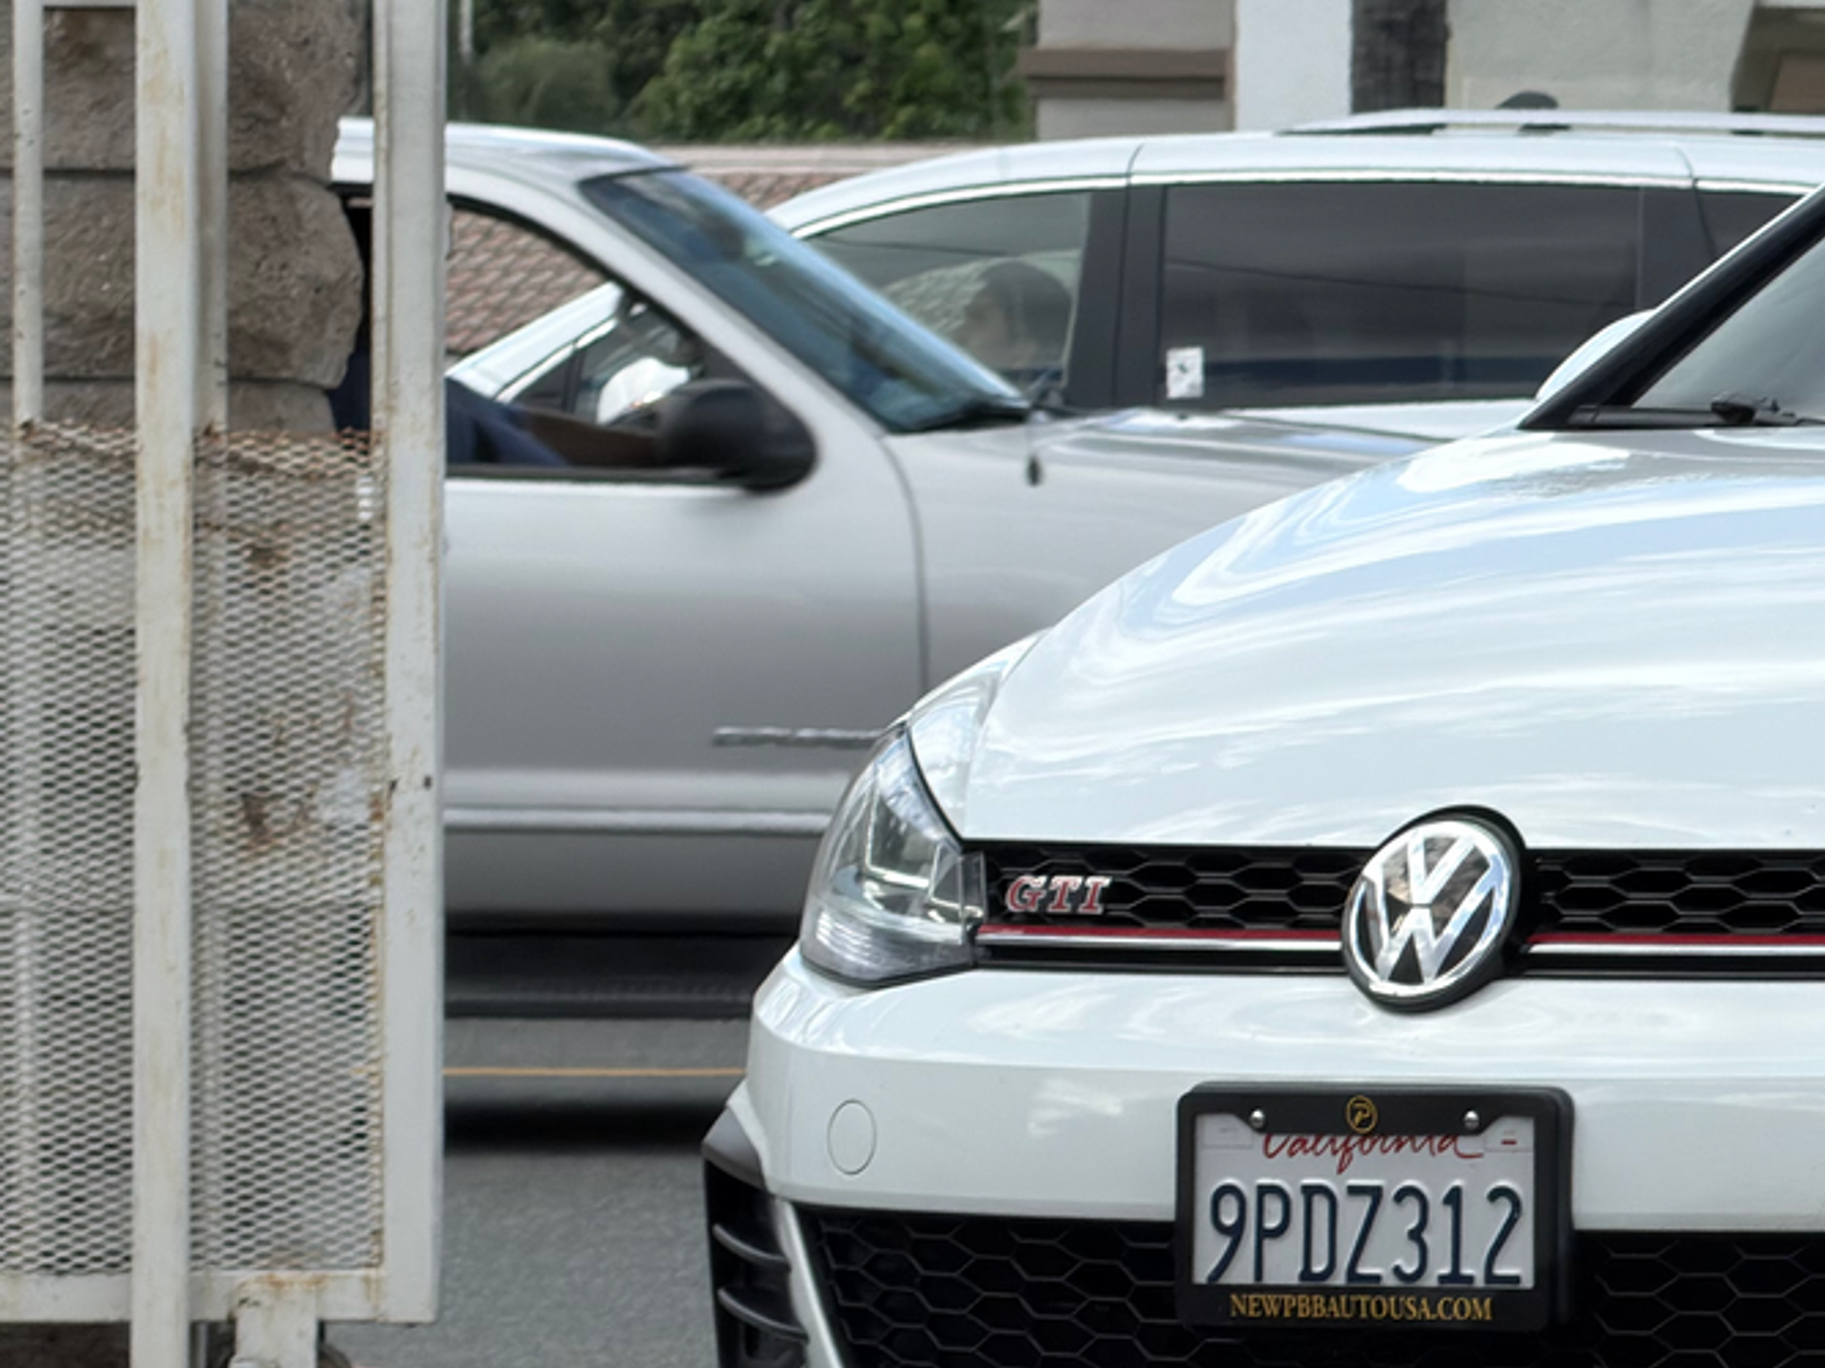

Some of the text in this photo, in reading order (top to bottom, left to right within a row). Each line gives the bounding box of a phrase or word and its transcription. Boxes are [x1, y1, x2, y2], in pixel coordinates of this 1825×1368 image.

[1005, 875, 1112, 915] GTI
[1206, 1182, 1523, 1286] 9PDZ312
[1230, 1294, 1493, 1321] NEWPBBAUTOUSA.COM
